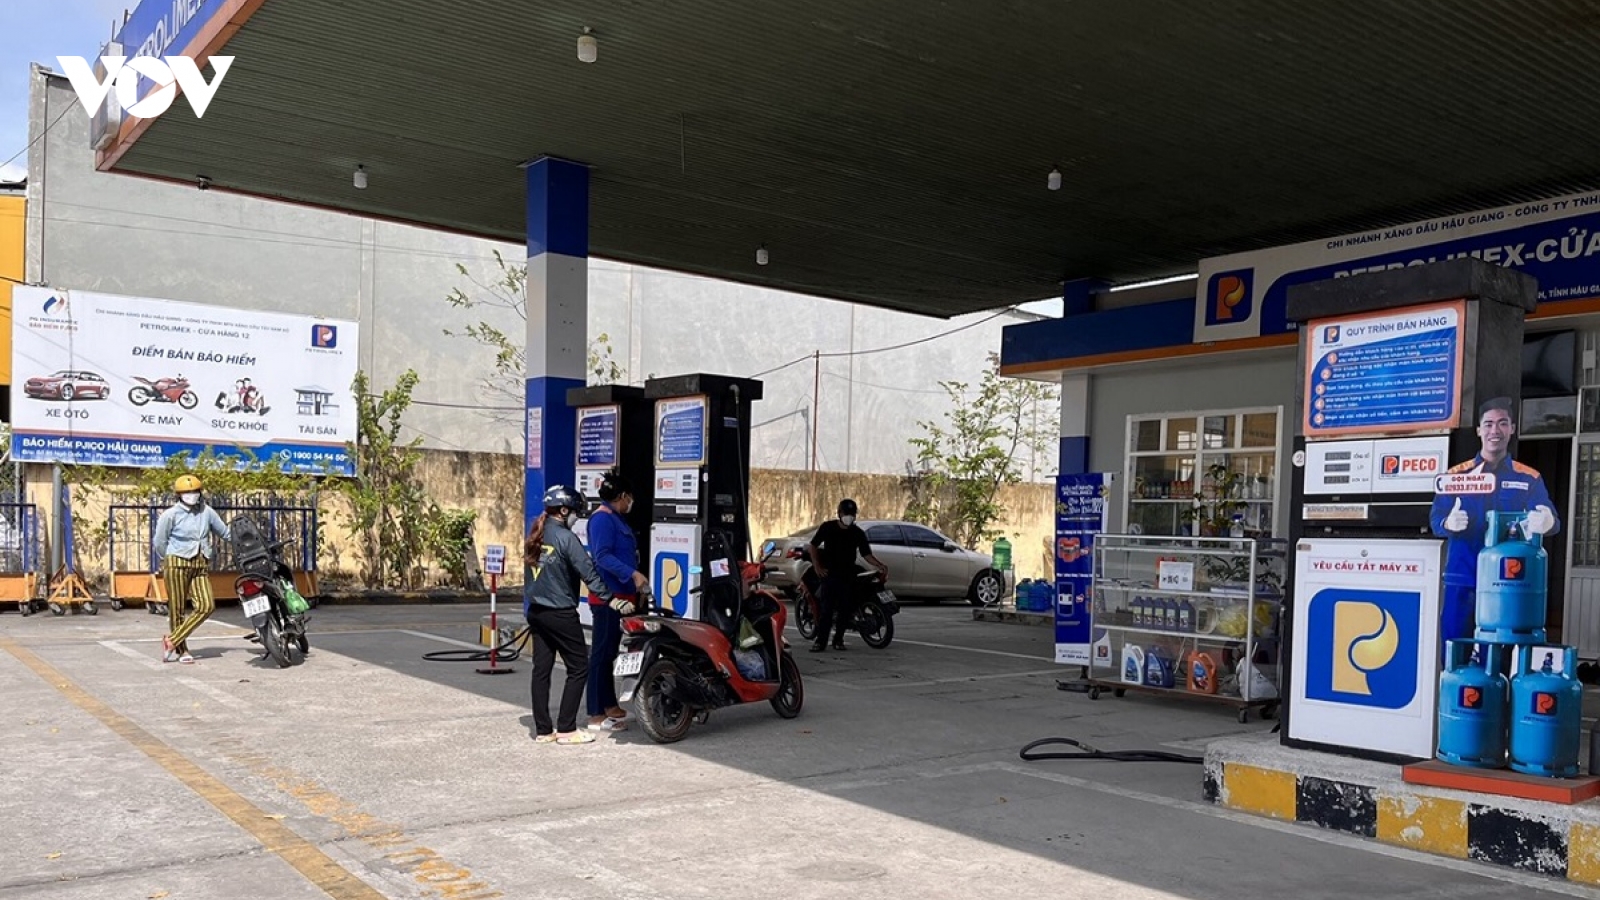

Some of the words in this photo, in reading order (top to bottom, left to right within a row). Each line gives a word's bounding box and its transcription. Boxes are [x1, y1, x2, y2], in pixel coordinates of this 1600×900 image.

[1327, 240, 1343, 249] CHI
[1346, 233, 1381, 246] NHÁNH
[1384, 228, 1413, 240] XĂNG
[1441, 217, 1465, 230] HẬU
[1468, 211, 1505, 225] GIANG
[1515, 204, 1549, 217] CÔNG
[1553, 200, 1569, 210] TY
[1573, 195, 1600, 207] TNH
[1570, 284, 1588, 296] HẬU
[140, 322, 191, 333] PETROLIMEX
[217, 328, 239, 338] HÀNG
[1346, 326, 1365, 337] QUY
[1368, 322, 1394, 334] TRÌNH
[1397, 320, 1417, 331] BÁN
[1420, 316, 1447, 328] HÀNG
[132, 344, 164, 357] ĐIỂM
[167, 347, 194, 360] BÁN
[197, 350, 223, 363] BẢO
[226, 352, 256, 366] HIỂM
[45, 408, 61, 417] XE
[140, 414, 155, 424] XE
[158, 414, 183, 426] MÁY
[211, 418, 236, 429] SỨC
[23, 437, 45, 447] BẢO
[47, 437, 73, 448] HIỂM
[75, 440, 105, 451] PJICO
[107, 441, 128, 453] HẬU
[130, 444, 162, 454] GIANG
[293, 451, 312, 460] 1900
[313, 452, 323, 460] 54
[1296, 453, 1303, 463] 2
[1402, 457, 1437, 472] PECO
[1313, 560, 1332, 570] YÊU
[1334, 559, 1354, 570] CẦU
[1357, 559, 1376, 571] TẮT
[1379, 562, 1402, 573] MÁY
[1405, 564, 1419, 573] XE
